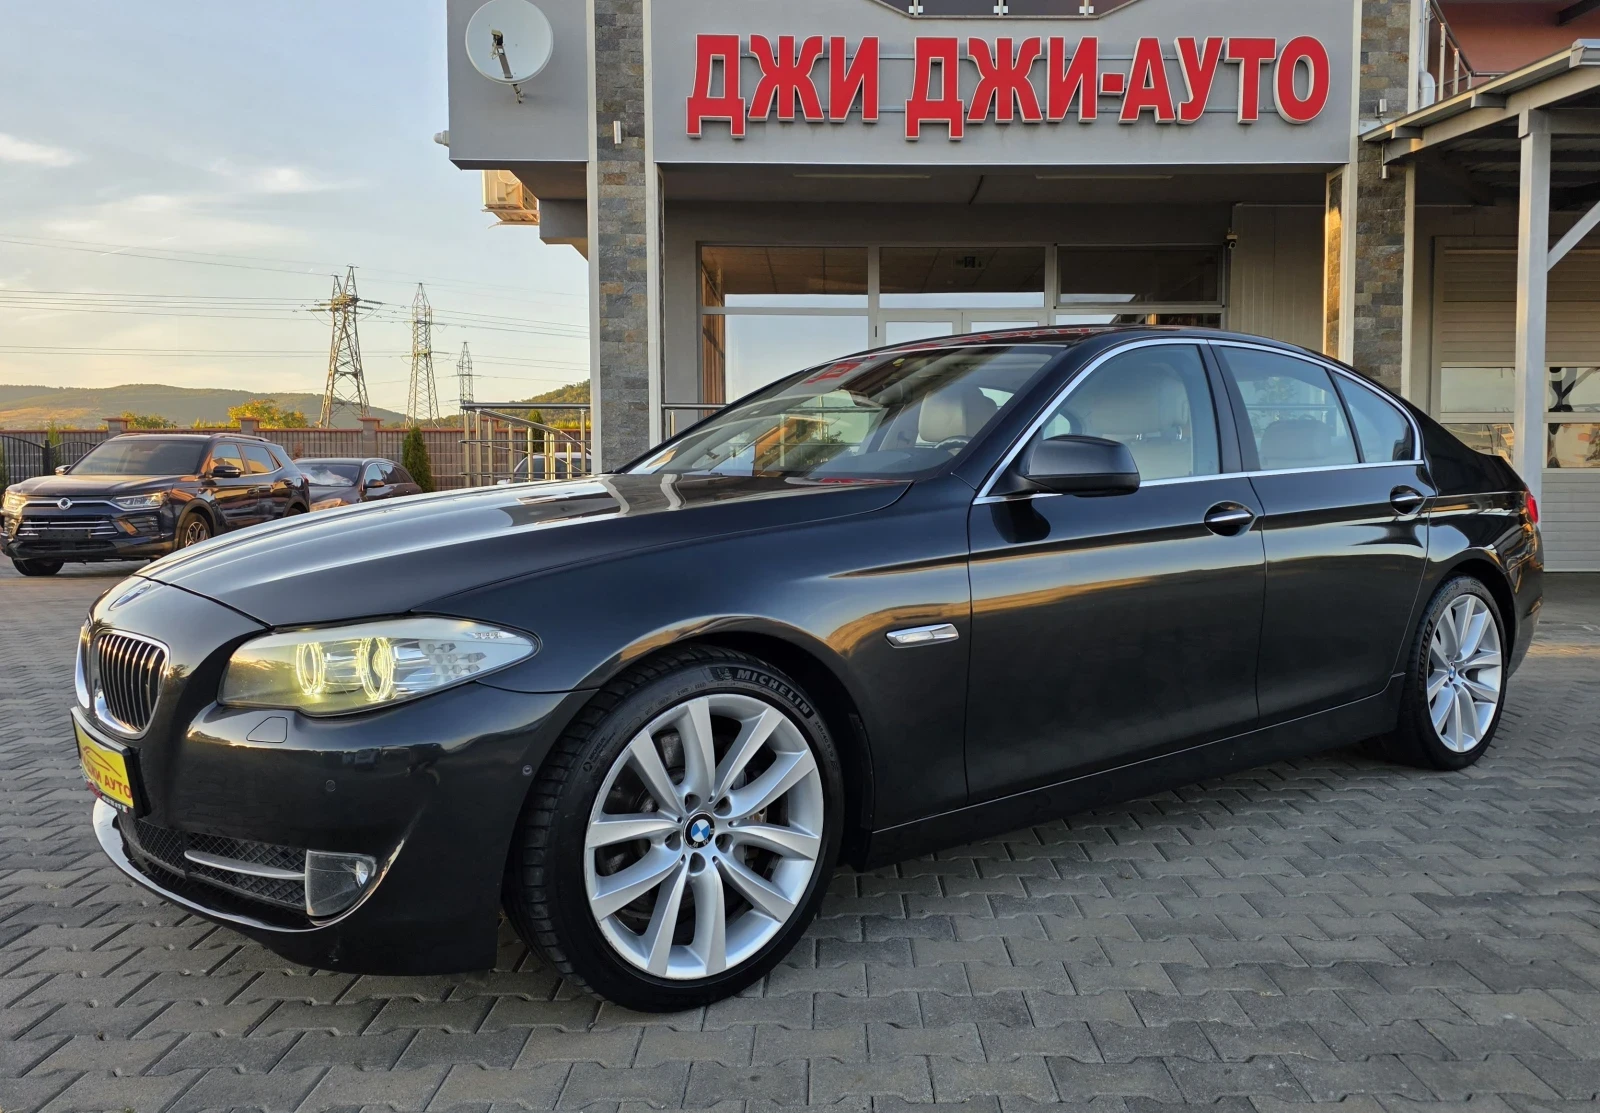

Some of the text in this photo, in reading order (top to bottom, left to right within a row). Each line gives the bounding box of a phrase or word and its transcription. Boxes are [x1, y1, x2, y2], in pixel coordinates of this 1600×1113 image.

[686, 34, 1332, 141] ДЖИ ДЖИ-АУТО
[1419, 623, 1433, 691] MICHELIN
[736, 669, 811, 715] MICHELIN
[104, 775, 132, 800] АУТО
